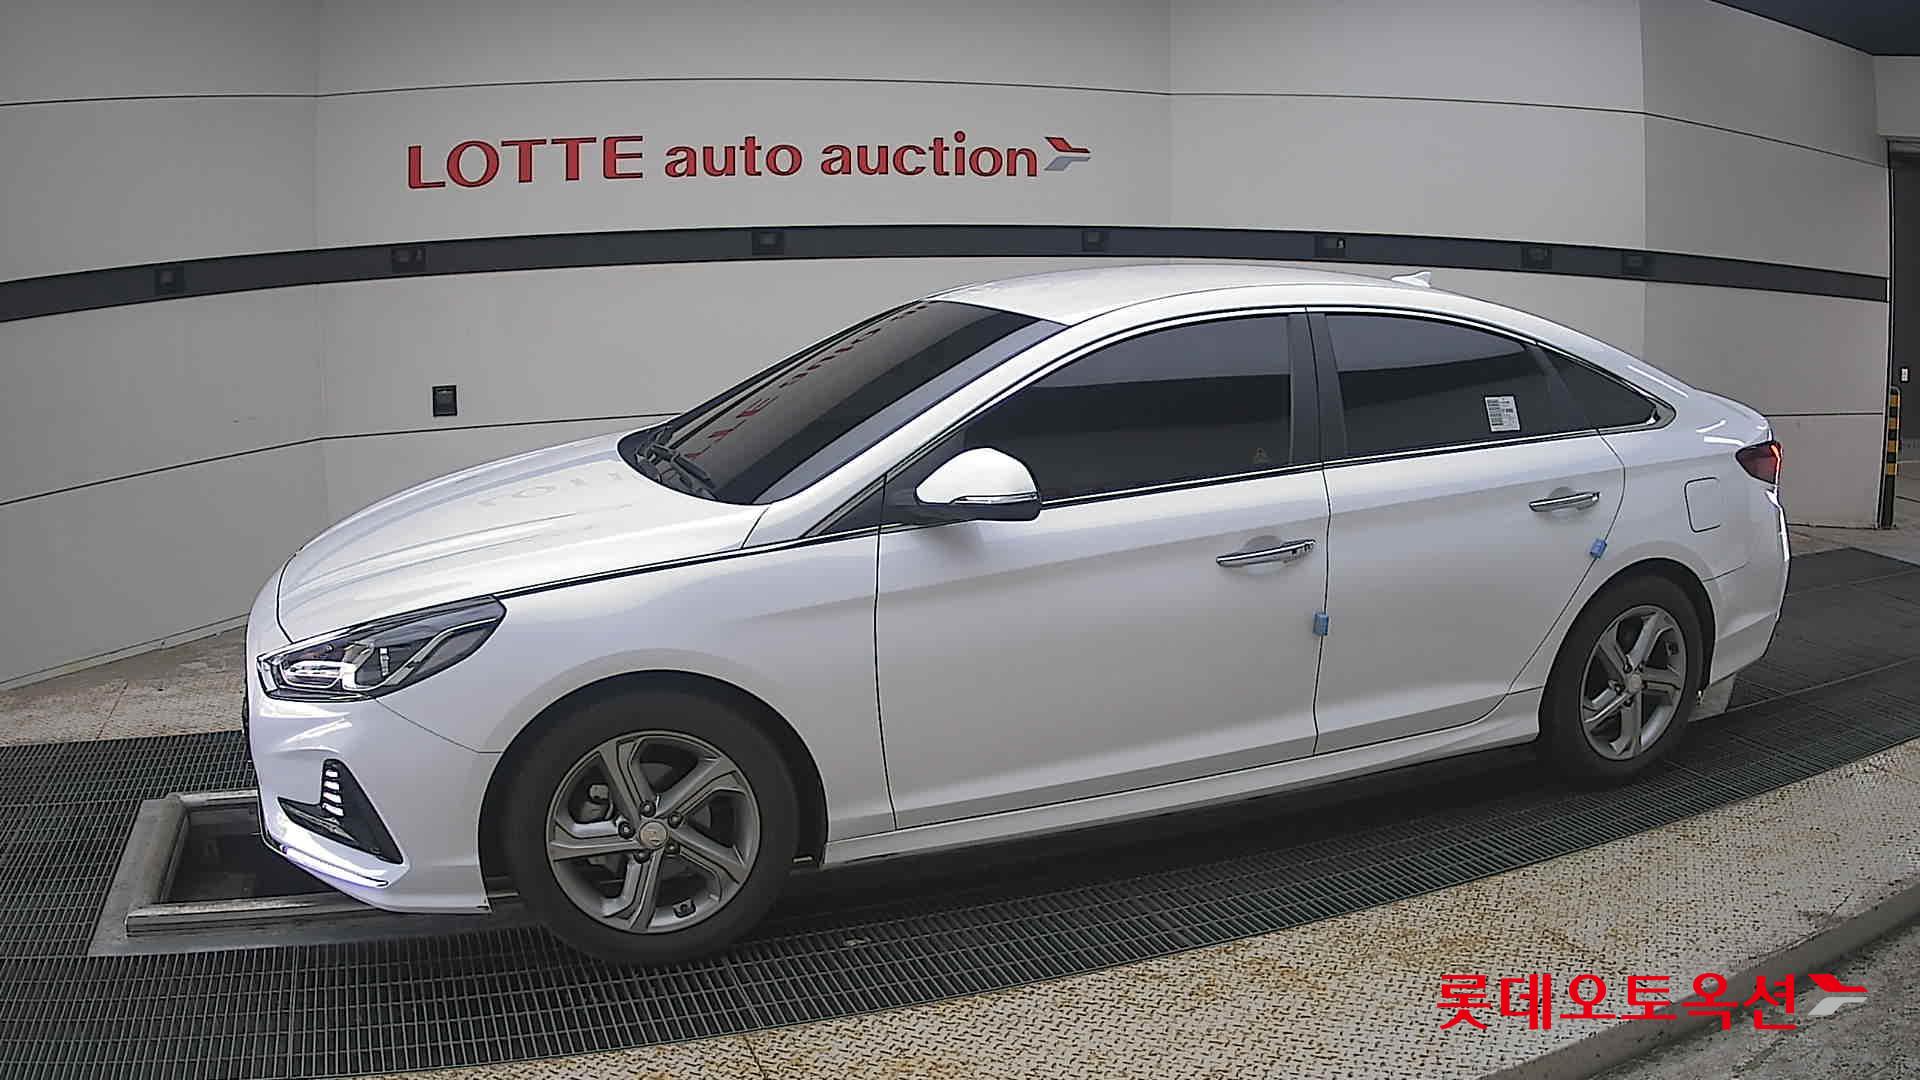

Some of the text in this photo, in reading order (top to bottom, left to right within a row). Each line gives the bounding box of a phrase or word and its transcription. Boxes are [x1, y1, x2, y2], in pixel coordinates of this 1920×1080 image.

[407, 130, 1039, 189] LOTTE auto auction
